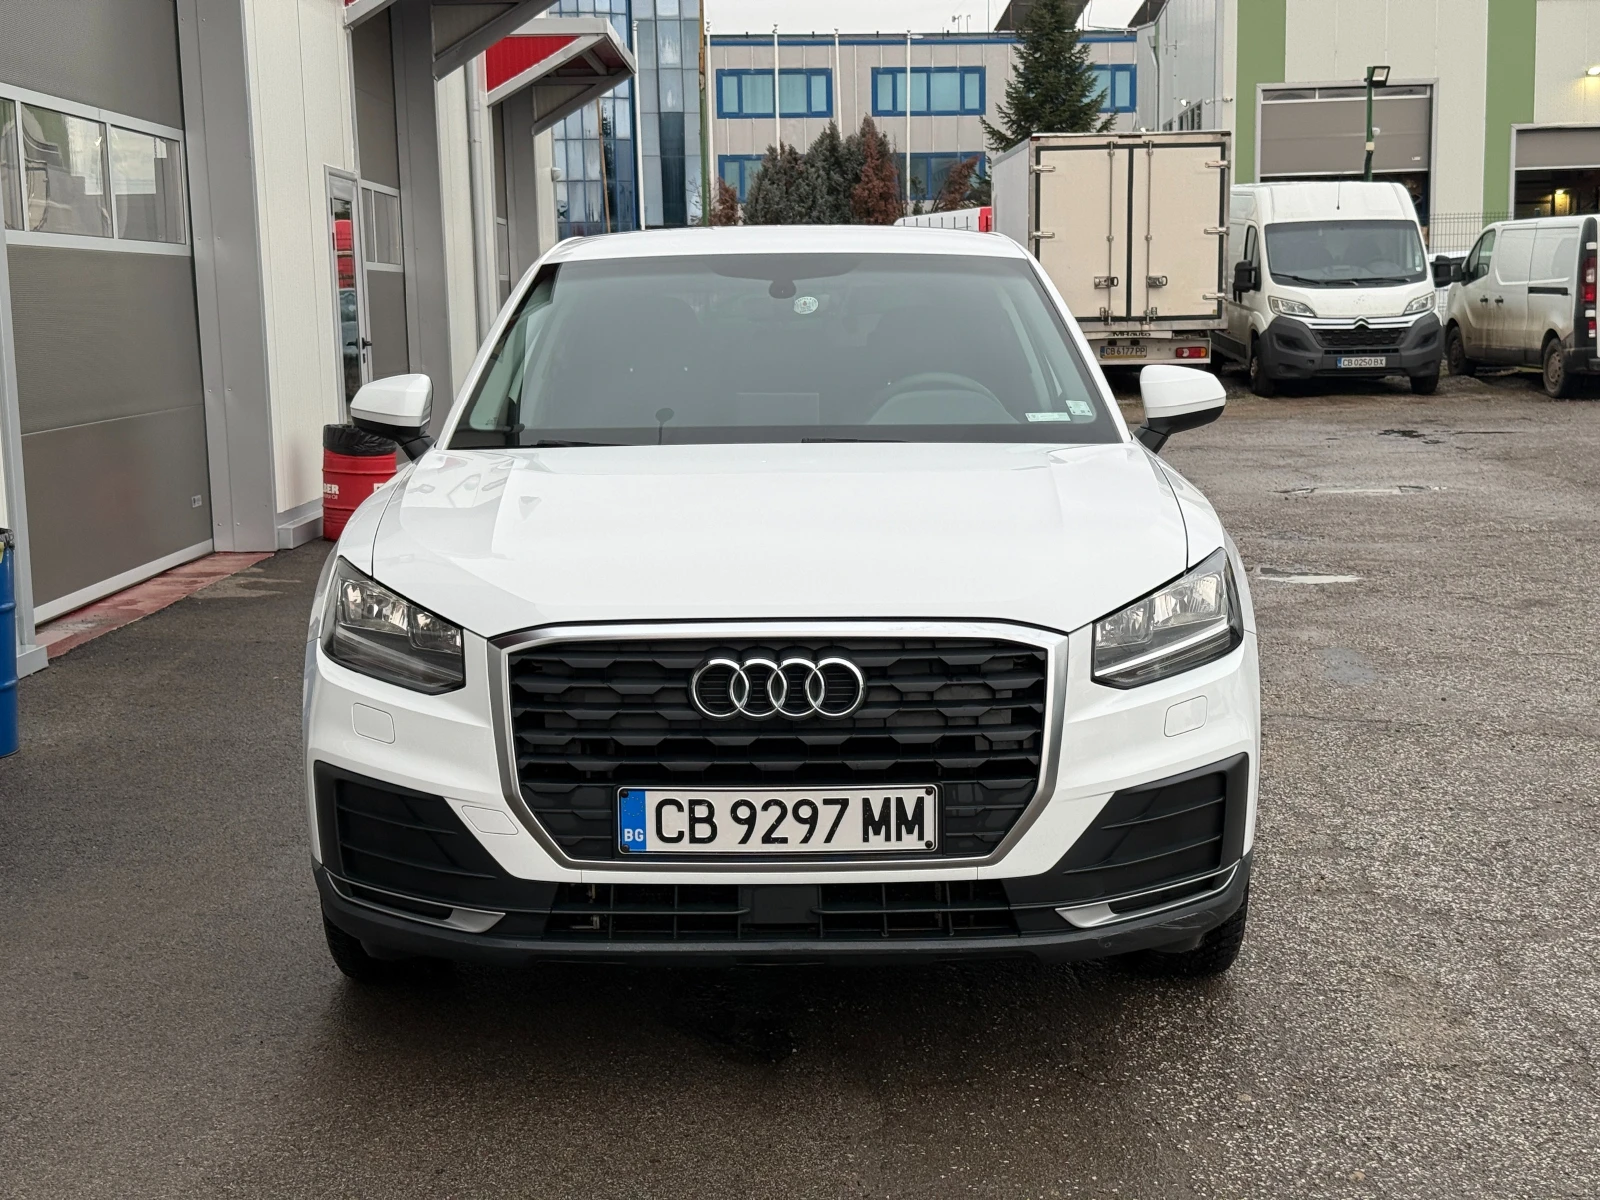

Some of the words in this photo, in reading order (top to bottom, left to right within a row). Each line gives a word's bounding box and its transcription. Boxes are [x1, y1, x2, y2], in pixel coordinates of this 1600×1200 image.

[1117, 347, 1135, 355] 6177
[1342, 358, 1353, 366] CB
[1354, 358, 1372, 366] 0250
[655, 798, 718, 844] CB
[730, 798, 850, 844] 9297
[861, 796, 925, 843] MM
[624, 828, 644, 842] BG
